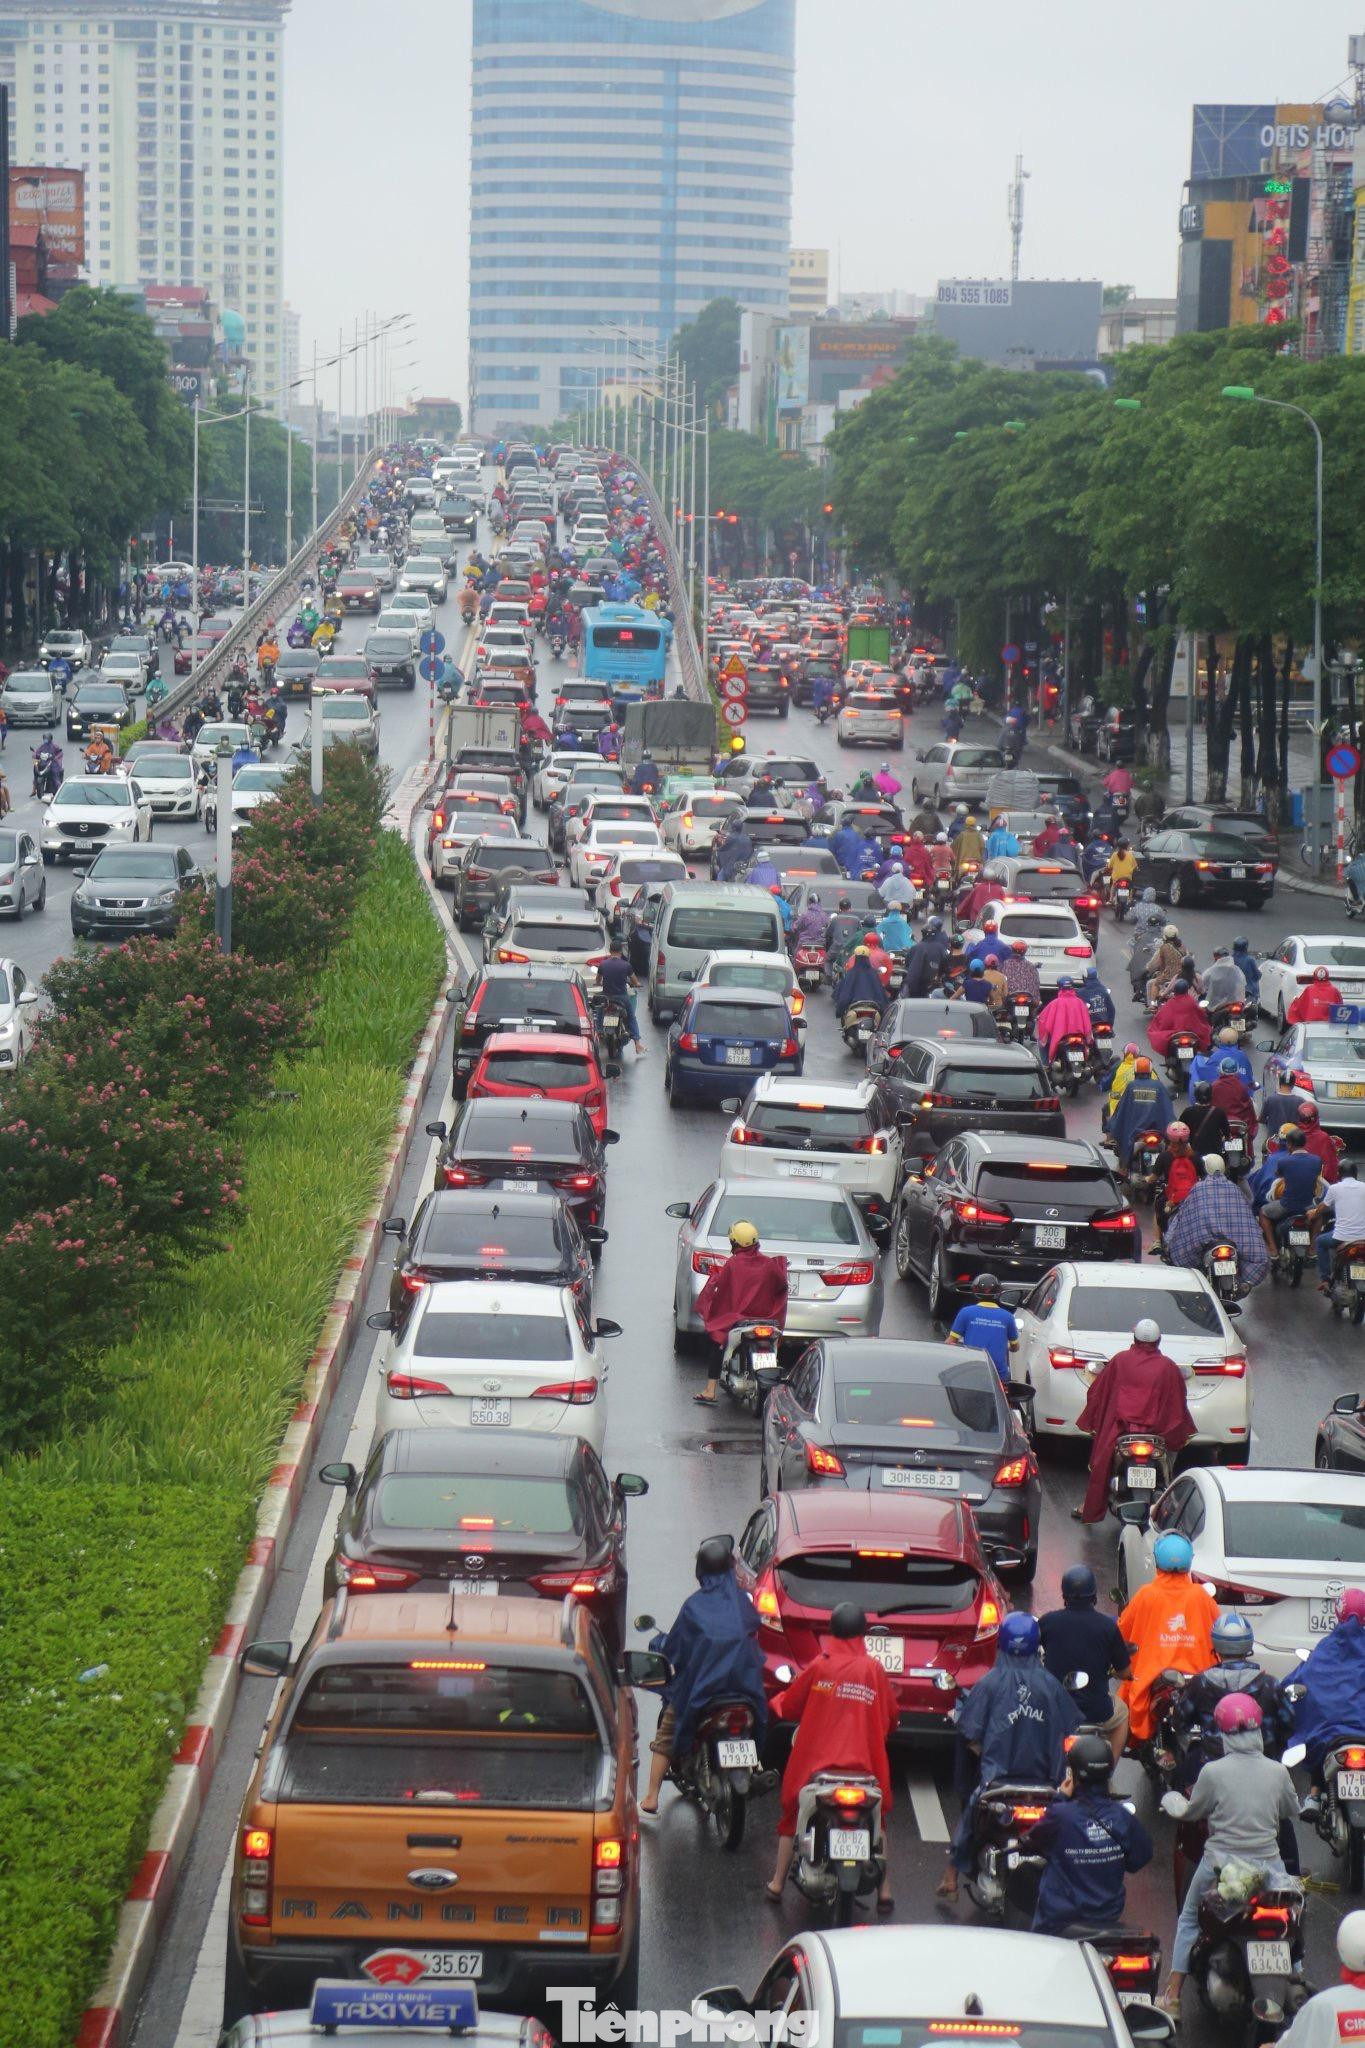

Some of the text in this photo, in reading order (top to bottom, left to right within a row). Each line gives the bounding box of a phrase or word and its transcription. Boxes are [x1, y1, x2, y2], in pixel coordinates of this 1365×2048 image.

[1260, 125, 1310, 148] OBIS
[938, 288, 1008, 304] 094 555 1085
[1043, 1226, 1060, 1237] 30G
[481, 1398, 502, 1411] 30F
[866, 1637, 892, 1654] 30E
[281, 1899, 582, 1926] RANGER
